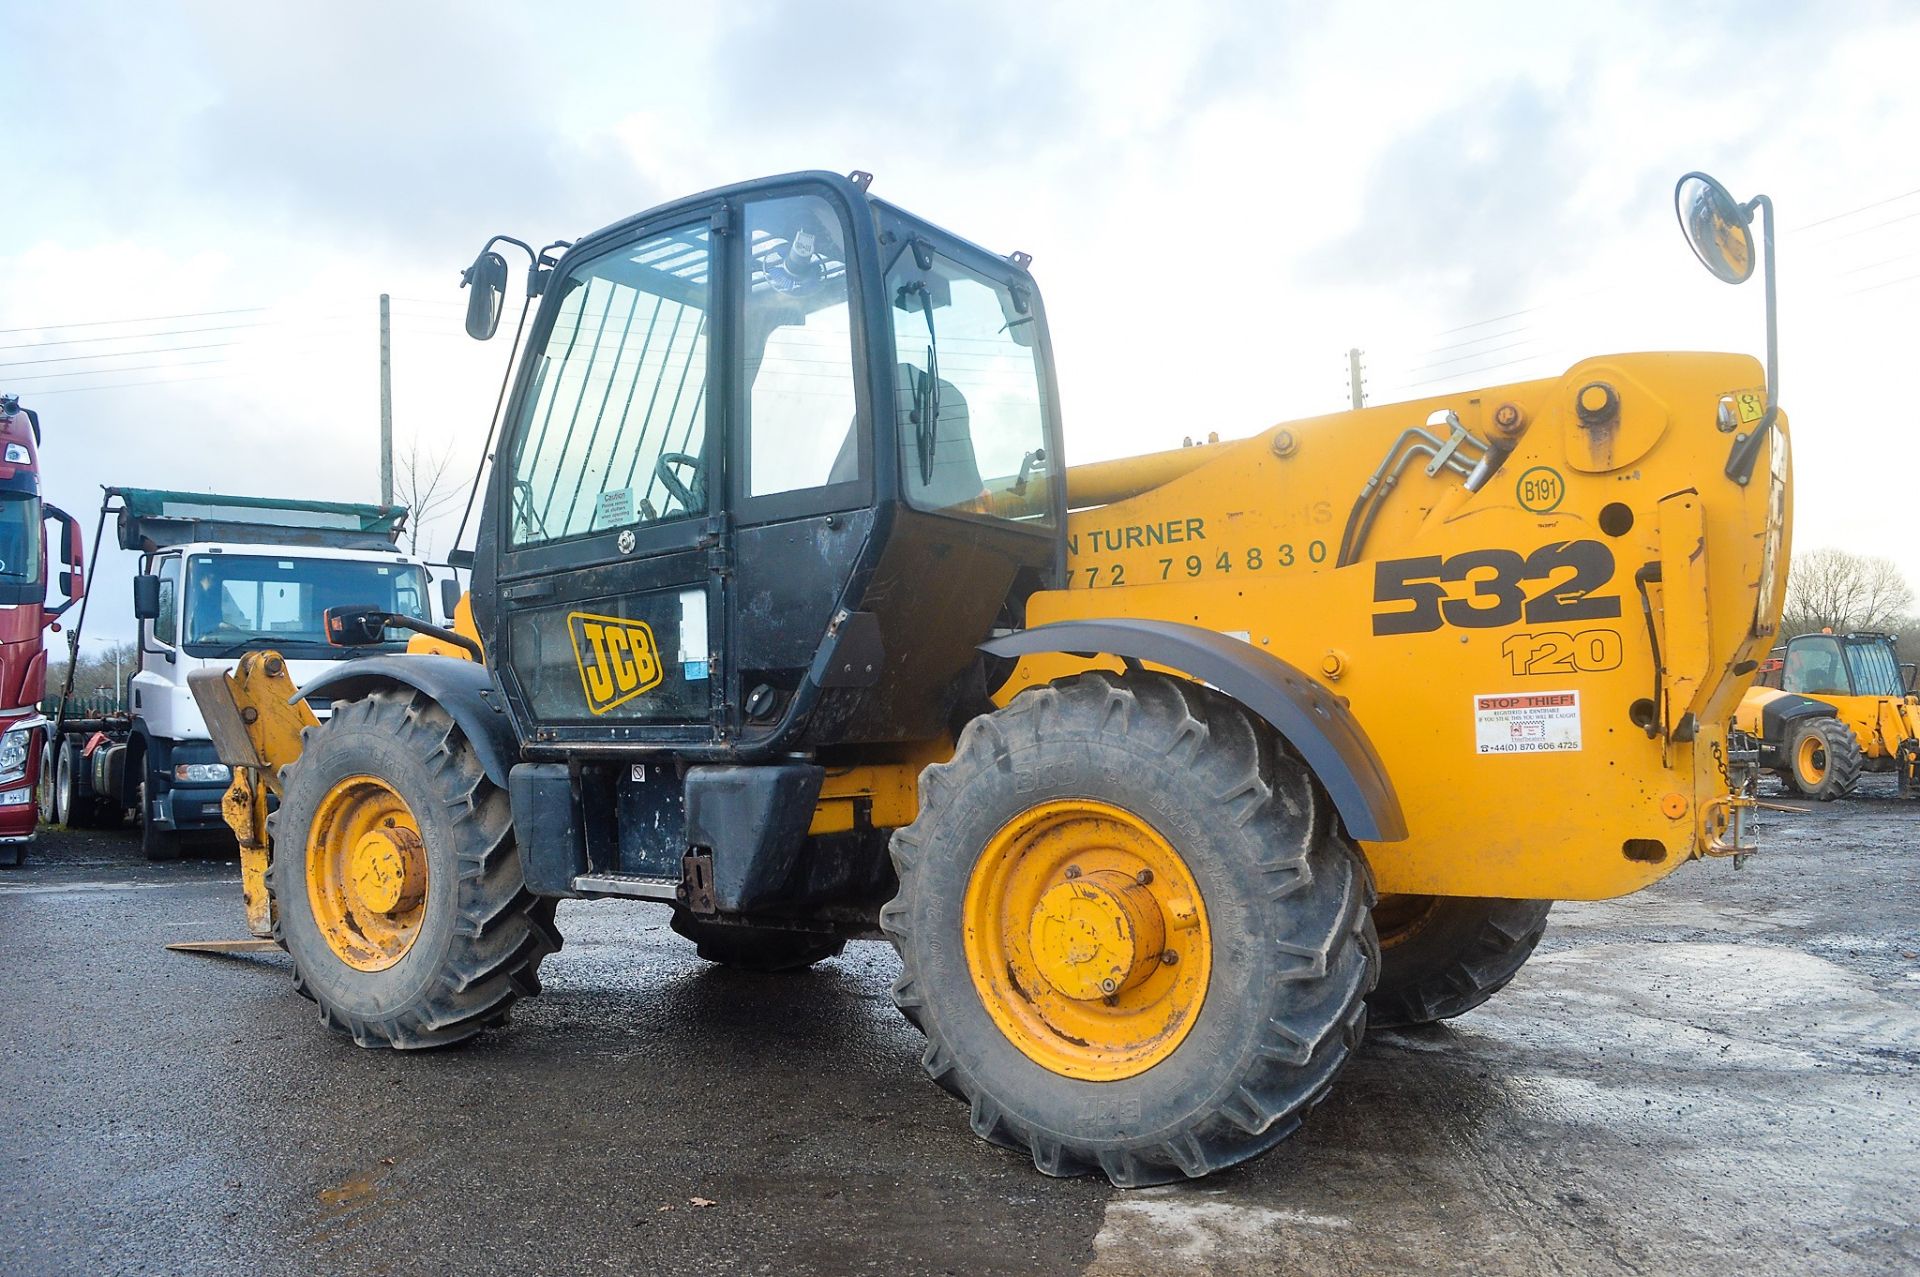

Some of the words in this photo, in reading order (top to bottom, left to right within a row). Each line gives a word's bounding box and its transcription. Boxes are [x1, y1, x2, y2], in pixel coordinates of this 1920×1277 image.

[1525, 478, 1557, 501] B191
[1088, 517, 1206, 554] TURNER
[1372, 539, 1622, 636] 532
[583, 622, 656, 702] JCB
[1502, 629, 1622, 676] 120
[1480, 698, 1520, 709] STOP
[1525, 695, 1575, 706] THIEF!
[1490, 744, 1517, 752] +44(0)
[1538, 742, 1555, 750] 606
